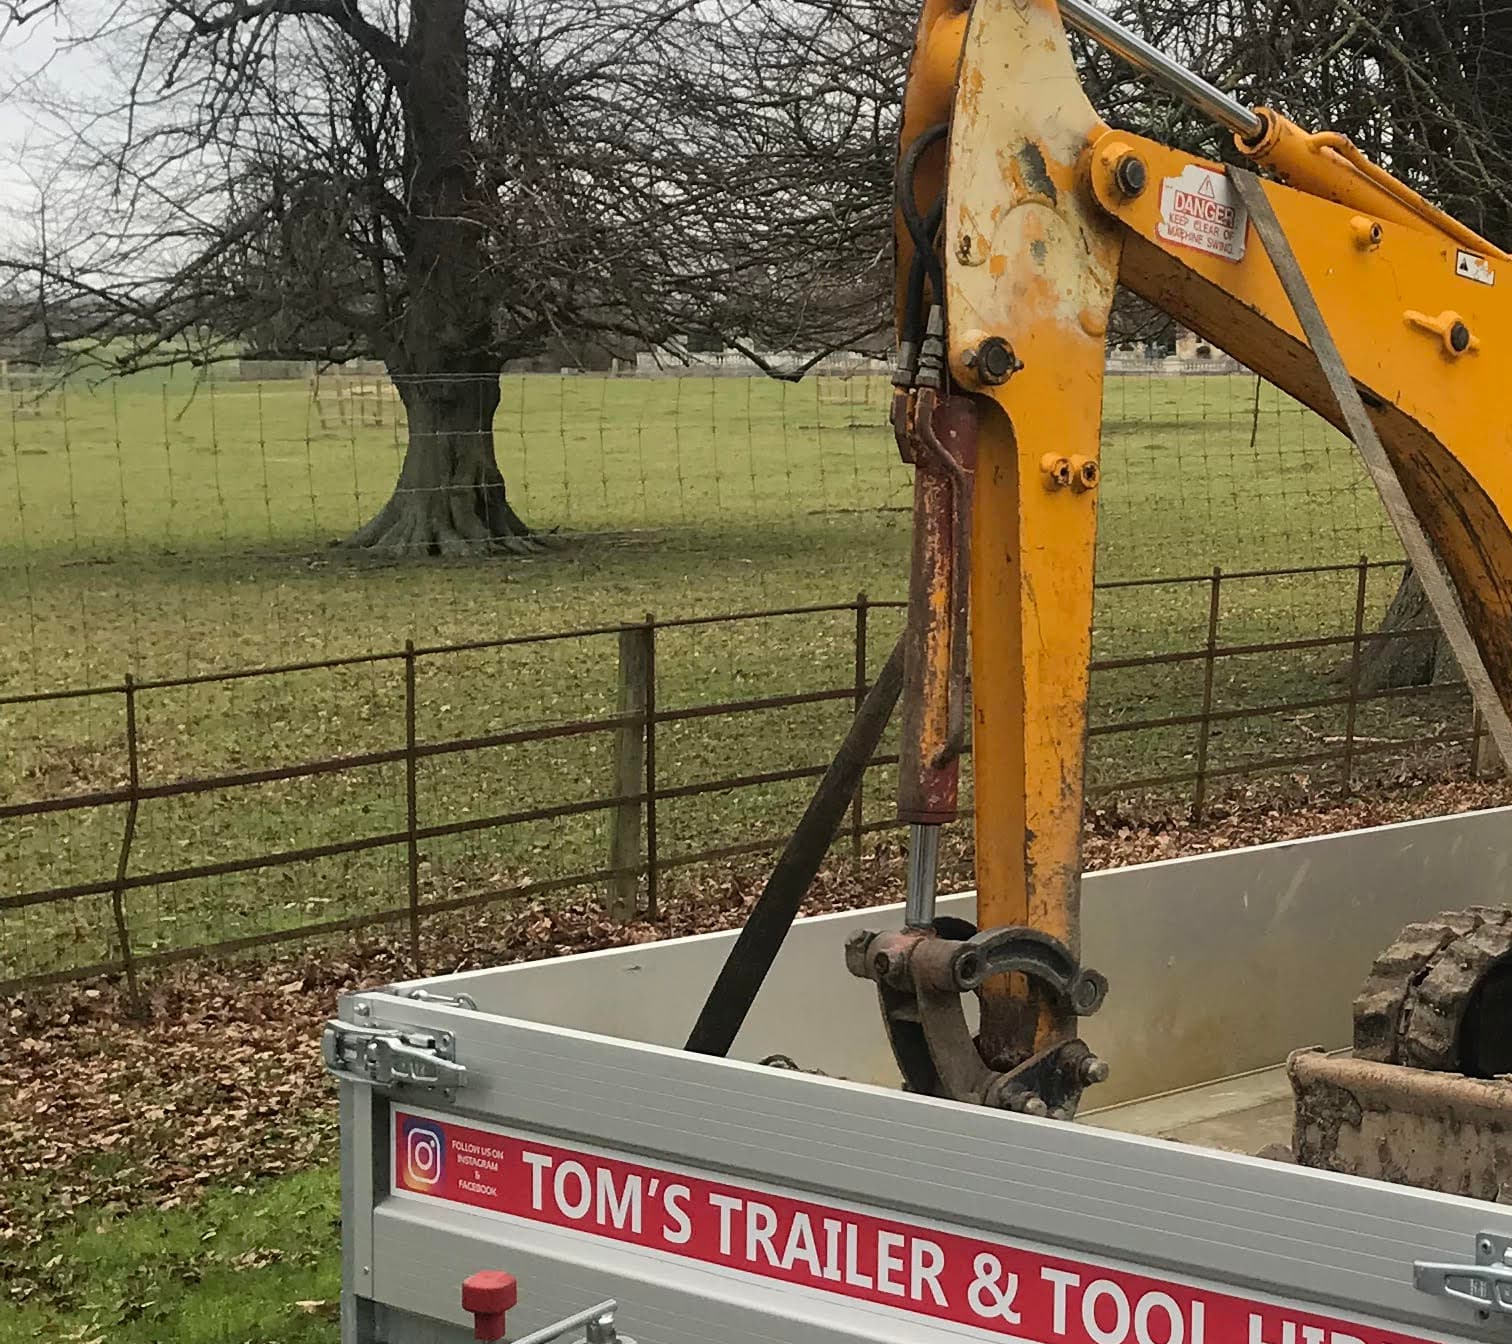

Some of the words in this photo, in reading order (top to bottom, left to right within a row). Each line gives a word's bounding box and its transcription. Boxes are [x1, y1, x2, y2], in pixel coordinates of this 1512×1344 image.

[1175, 191, 1235, 228] DANGER
[1169, 212, 1189, 225] KEEP
[1193, 218, 1220, 234] CLEAR
[451, 1140, 480, 1154] FOLLOW
[480, 1146, 492, 1157] US
[492, 1149, 504, 1160] ON
[457, 1154, 499, 1171] INSTAGRAM
[458, 1179, 498, 1196] FACEBOOK
[522, 1151, 693, 1244] TOM'S
[708, 1193, 949, 1308] TRAILER
[967, 1252, 1021, 1324] &
